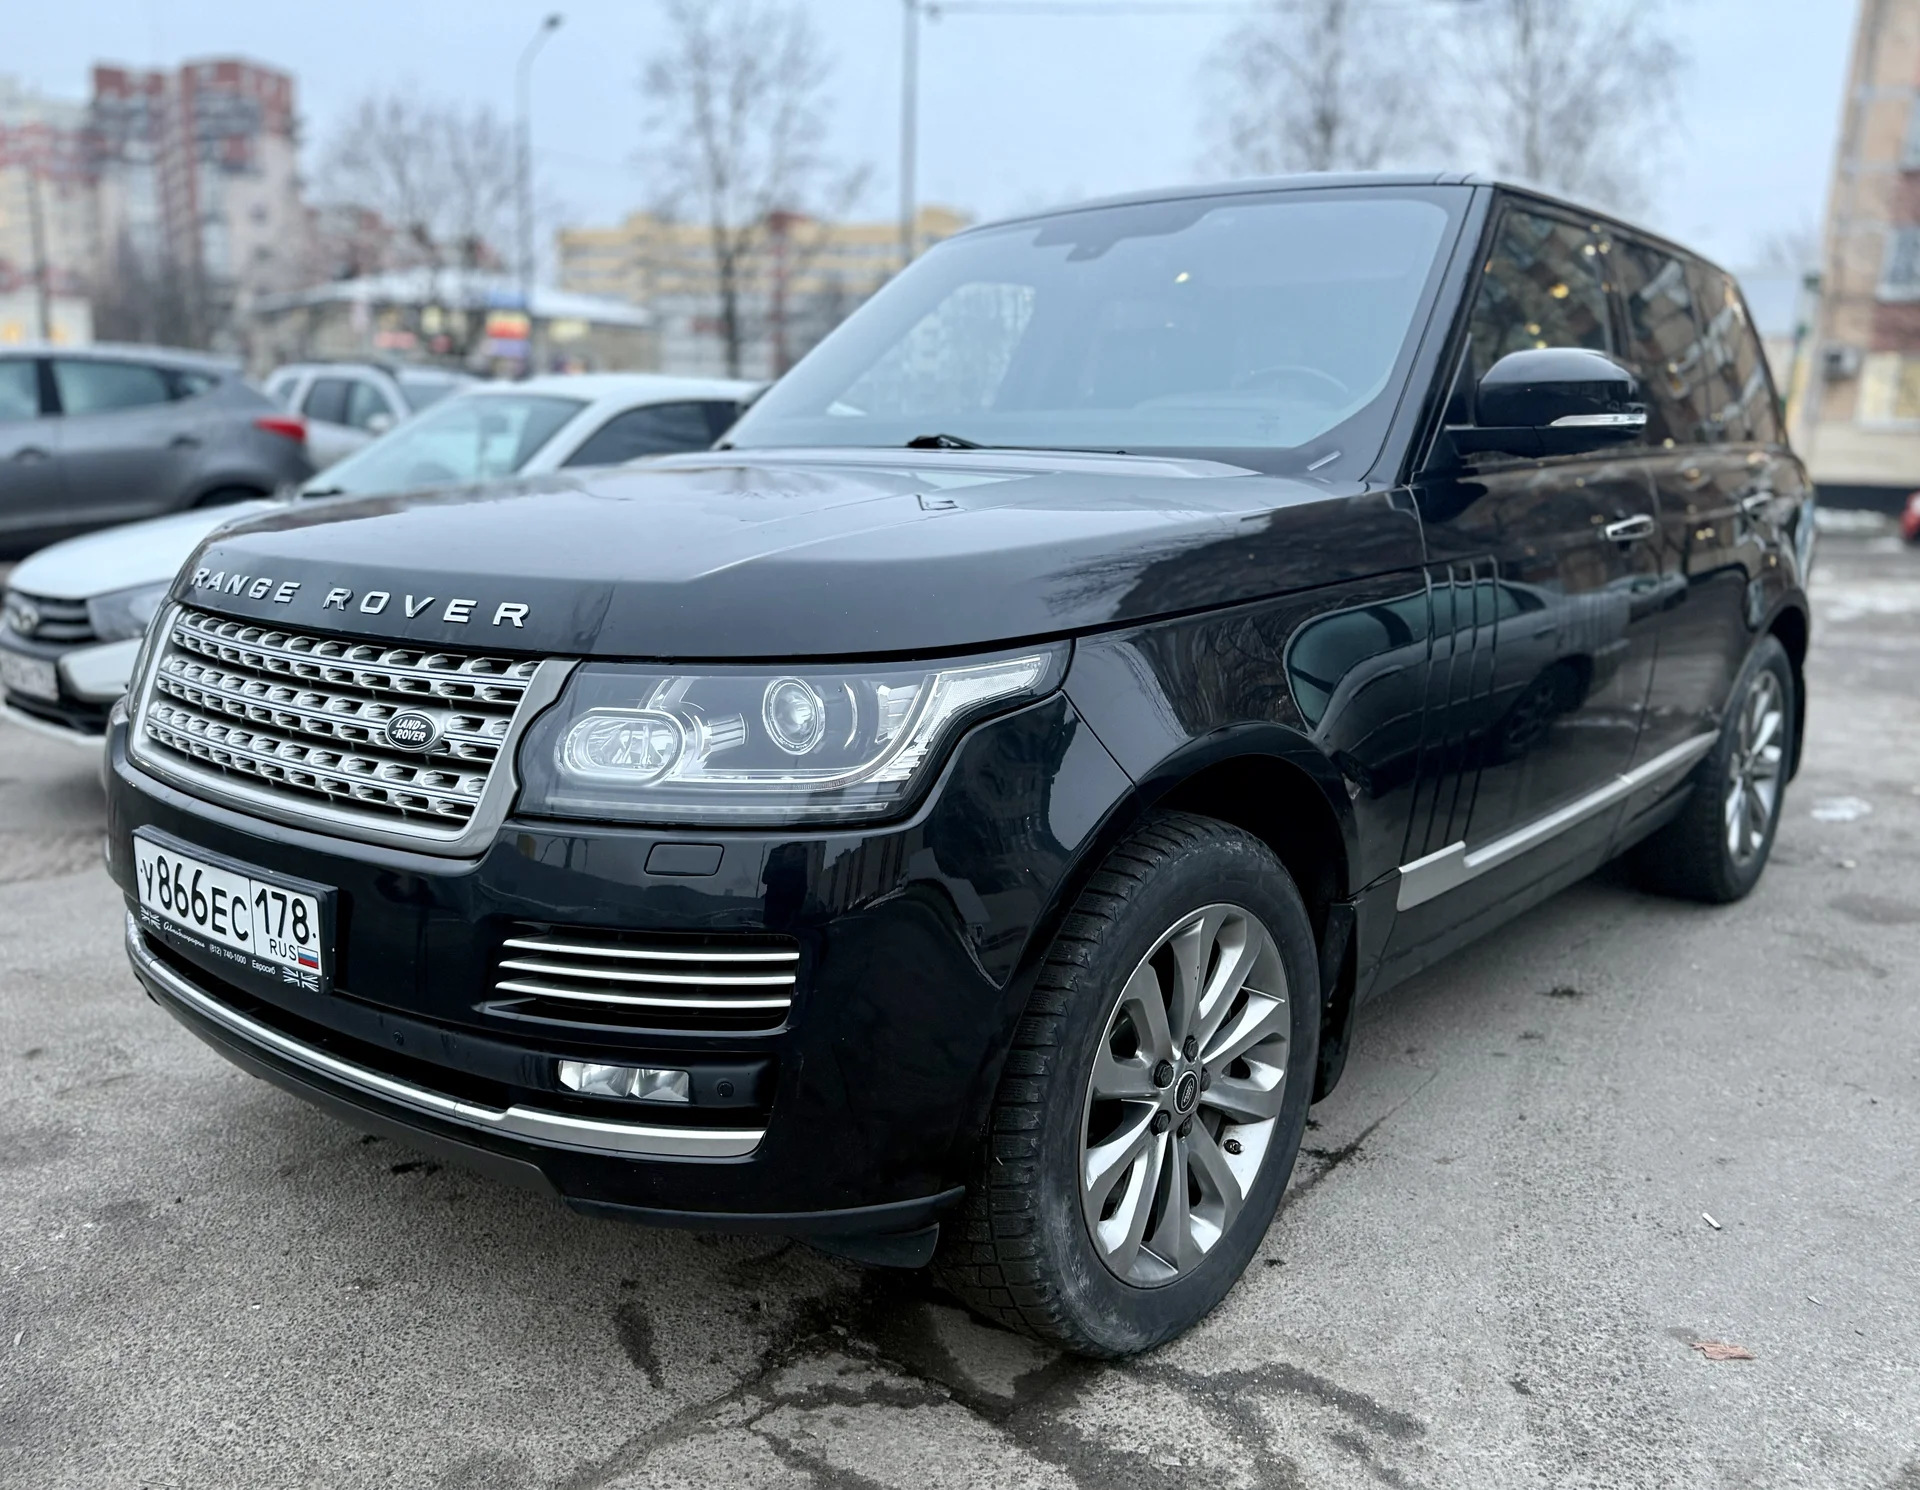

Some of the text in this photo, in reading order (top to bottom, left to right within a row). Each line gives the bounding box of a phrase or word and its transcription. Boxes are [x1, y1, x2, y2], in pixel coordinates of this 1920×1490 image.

[190, 567, 531, 628] RANGE ROVER
[395, 729, 427, 742] ROVER
[255, 888, 310, 945] 178
[209, 944, 222, 957] (812)
[223, 949, 247, 965] 740-1000
[251, 960, 276, 975] Евросиб
[269, 939, 297, 962] RUS
